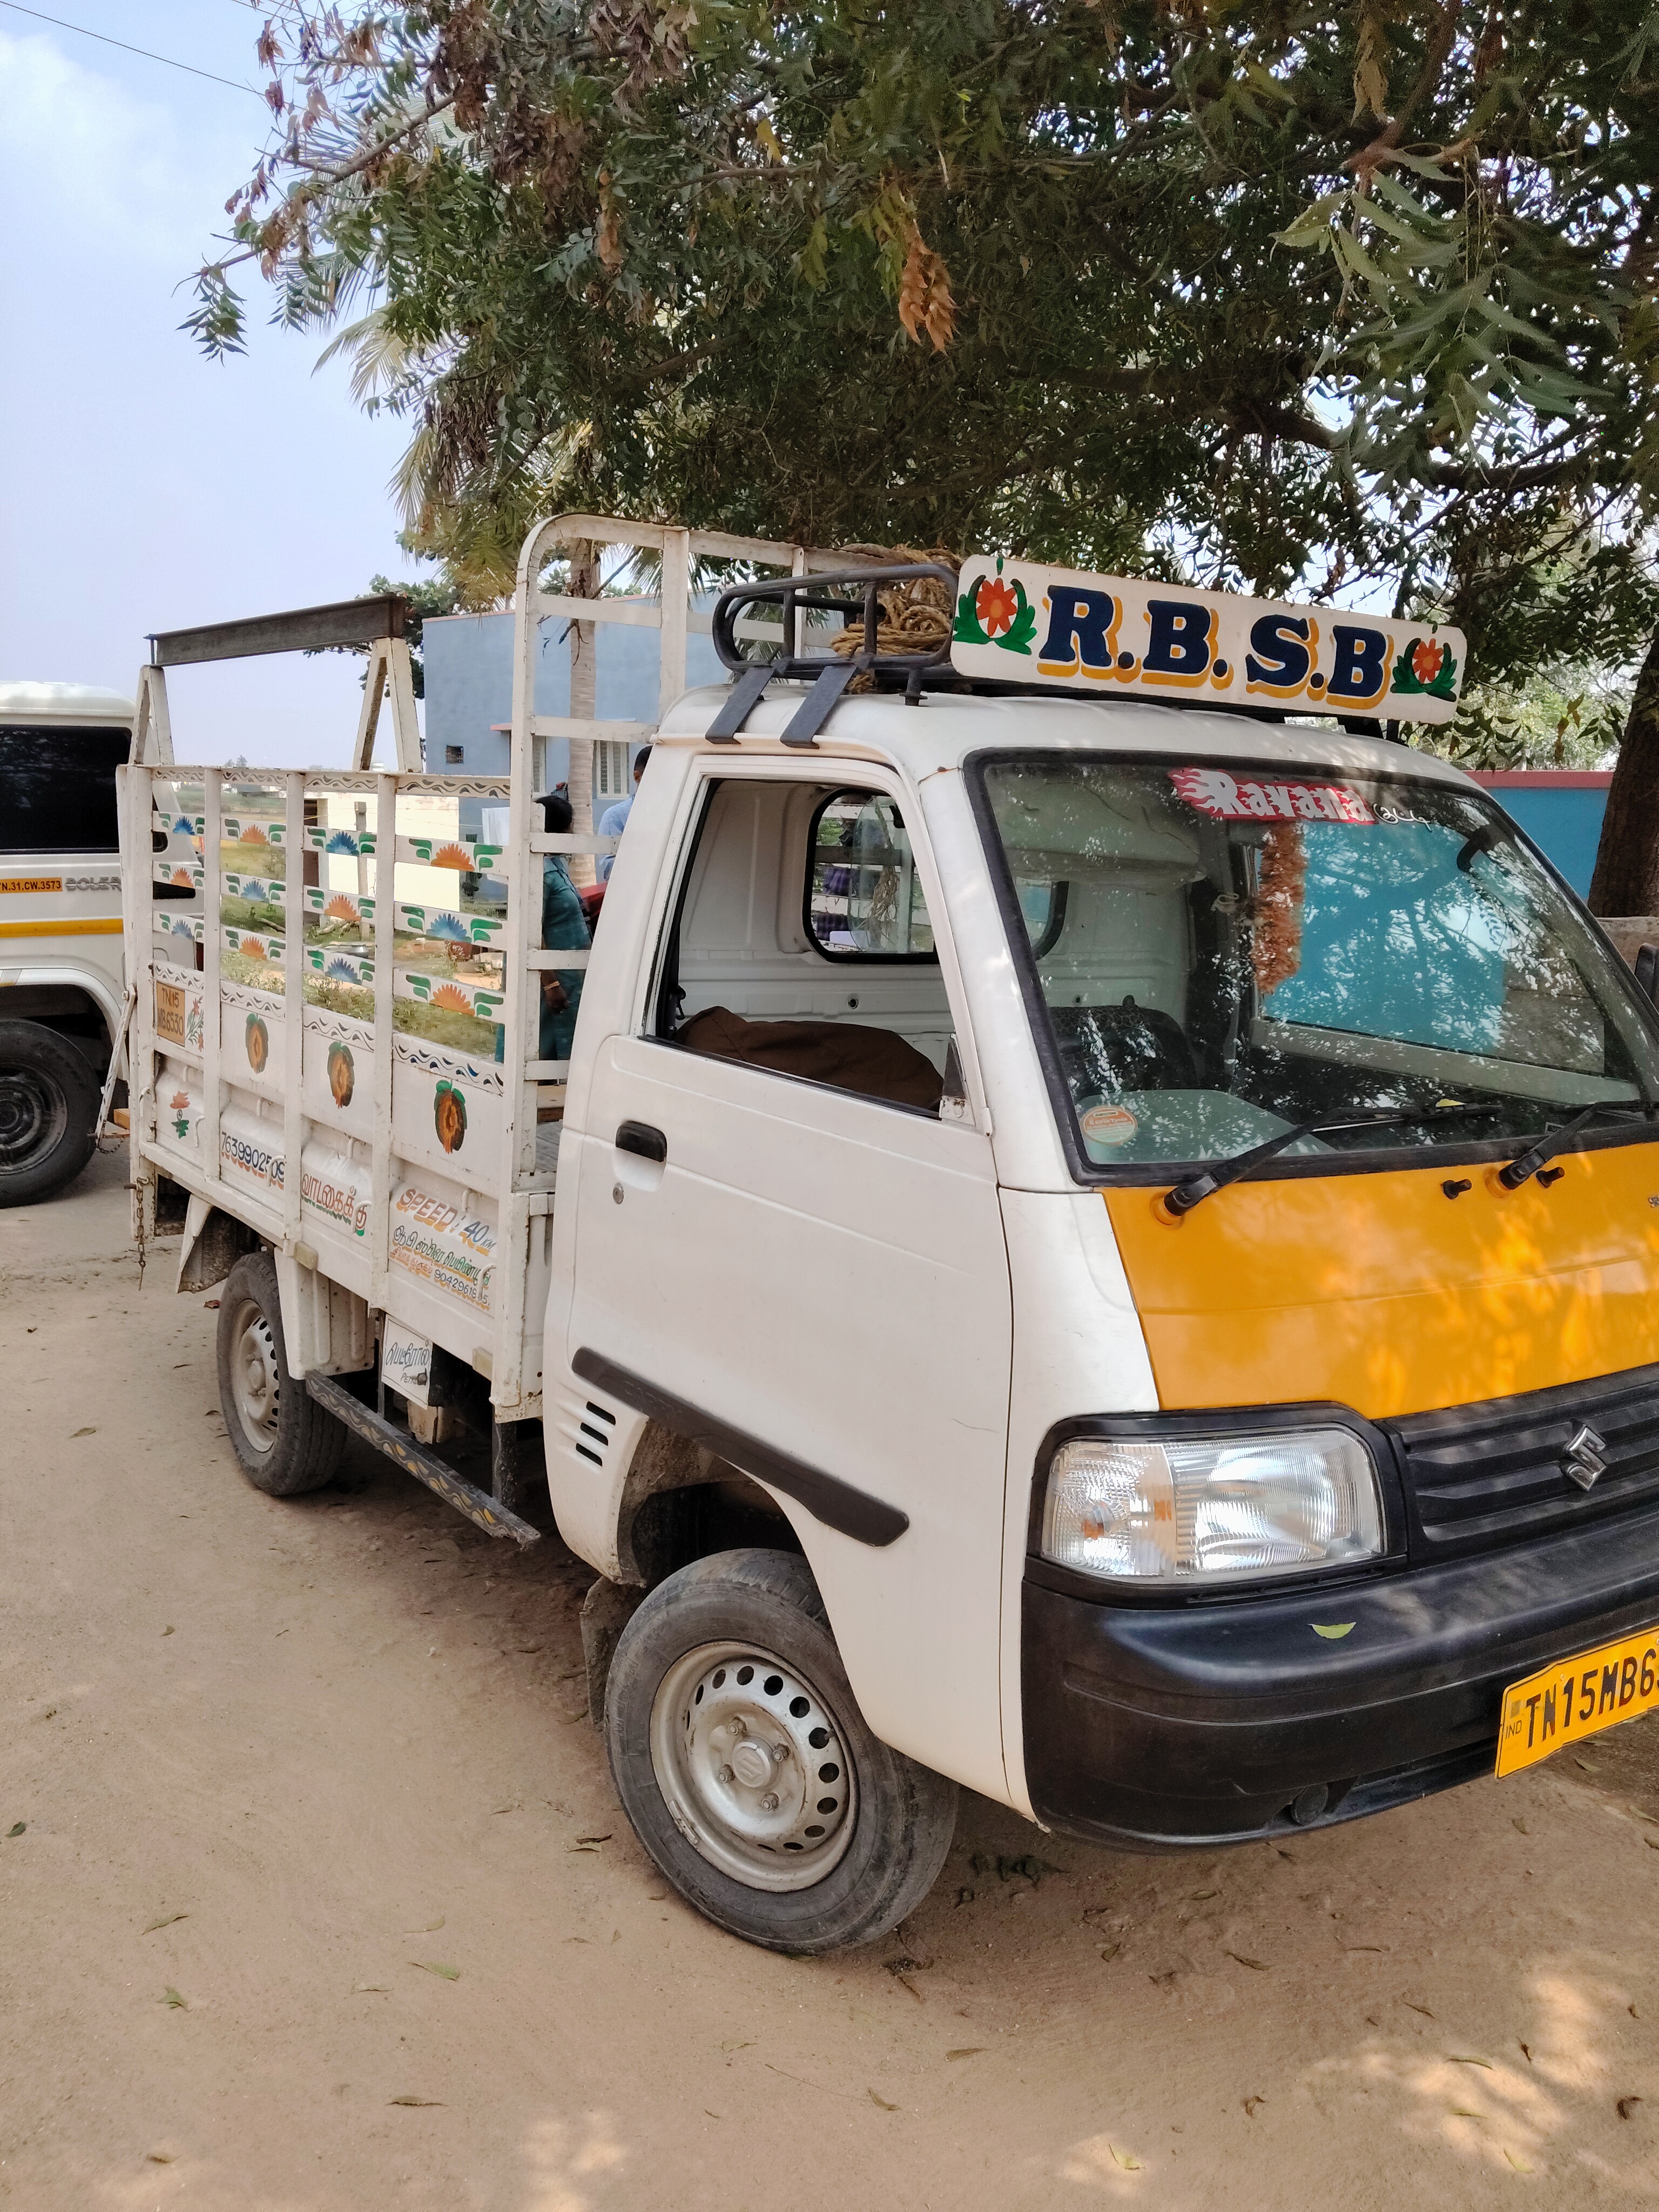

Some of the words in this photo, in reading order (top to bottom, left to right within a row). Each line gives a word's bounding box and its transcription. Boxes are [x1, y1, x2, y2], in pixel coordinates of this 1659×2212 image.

[1038, 584, 1392, 707] R.B.S.B
[0, 880, 62, 891] N.31.CW.3573
[65, 876, 122, 892] BOLER
[463, 1220, 490, 1243] 40
[1526, 1648, 1659, 1749] TN15MB6
[1505, 1719, 1522, 1740] IND
